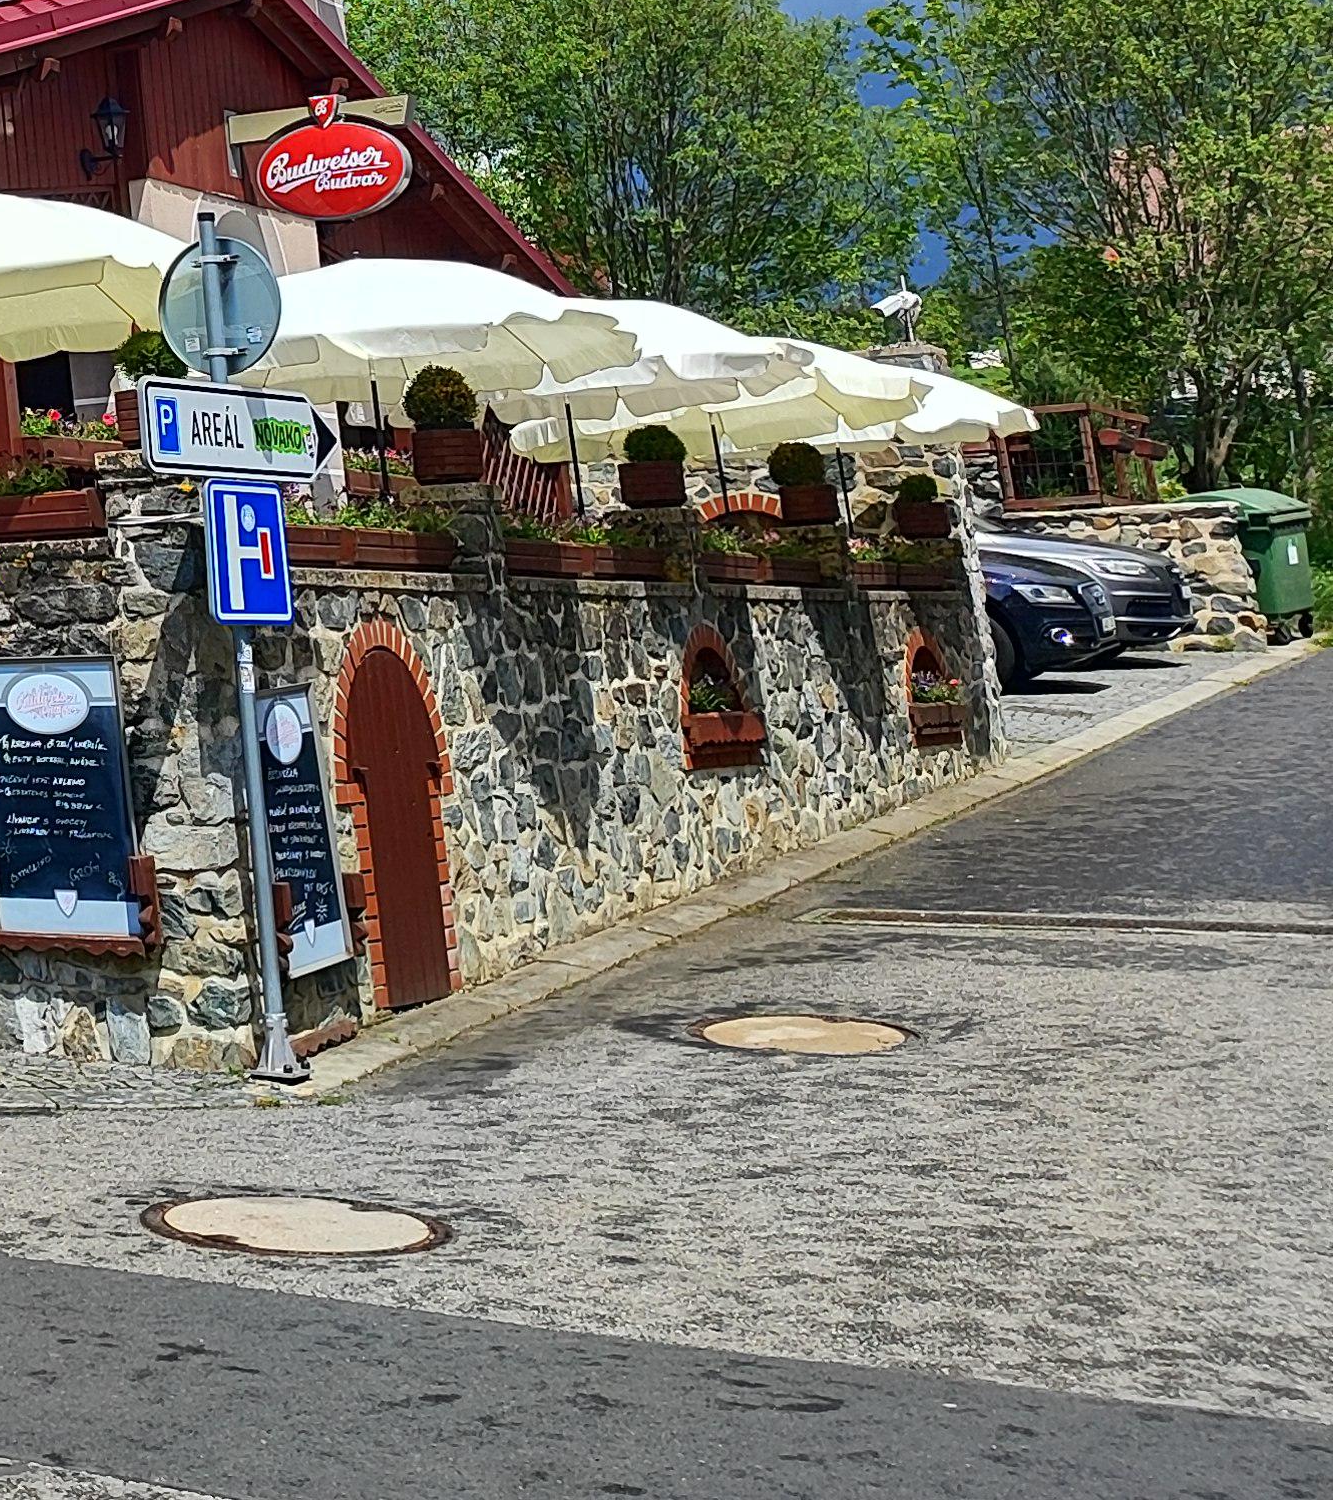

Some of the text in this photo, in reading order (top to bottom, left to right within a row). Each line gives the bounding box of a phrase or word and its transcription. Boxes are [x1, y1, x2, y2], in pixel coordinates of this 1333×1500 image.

[265, 145, 389, 191] Budweiser
[314, 171, 388, 193] Budvar
[159, 404, 174, 436] P
[191, 405, 244, 449] AREÁL
